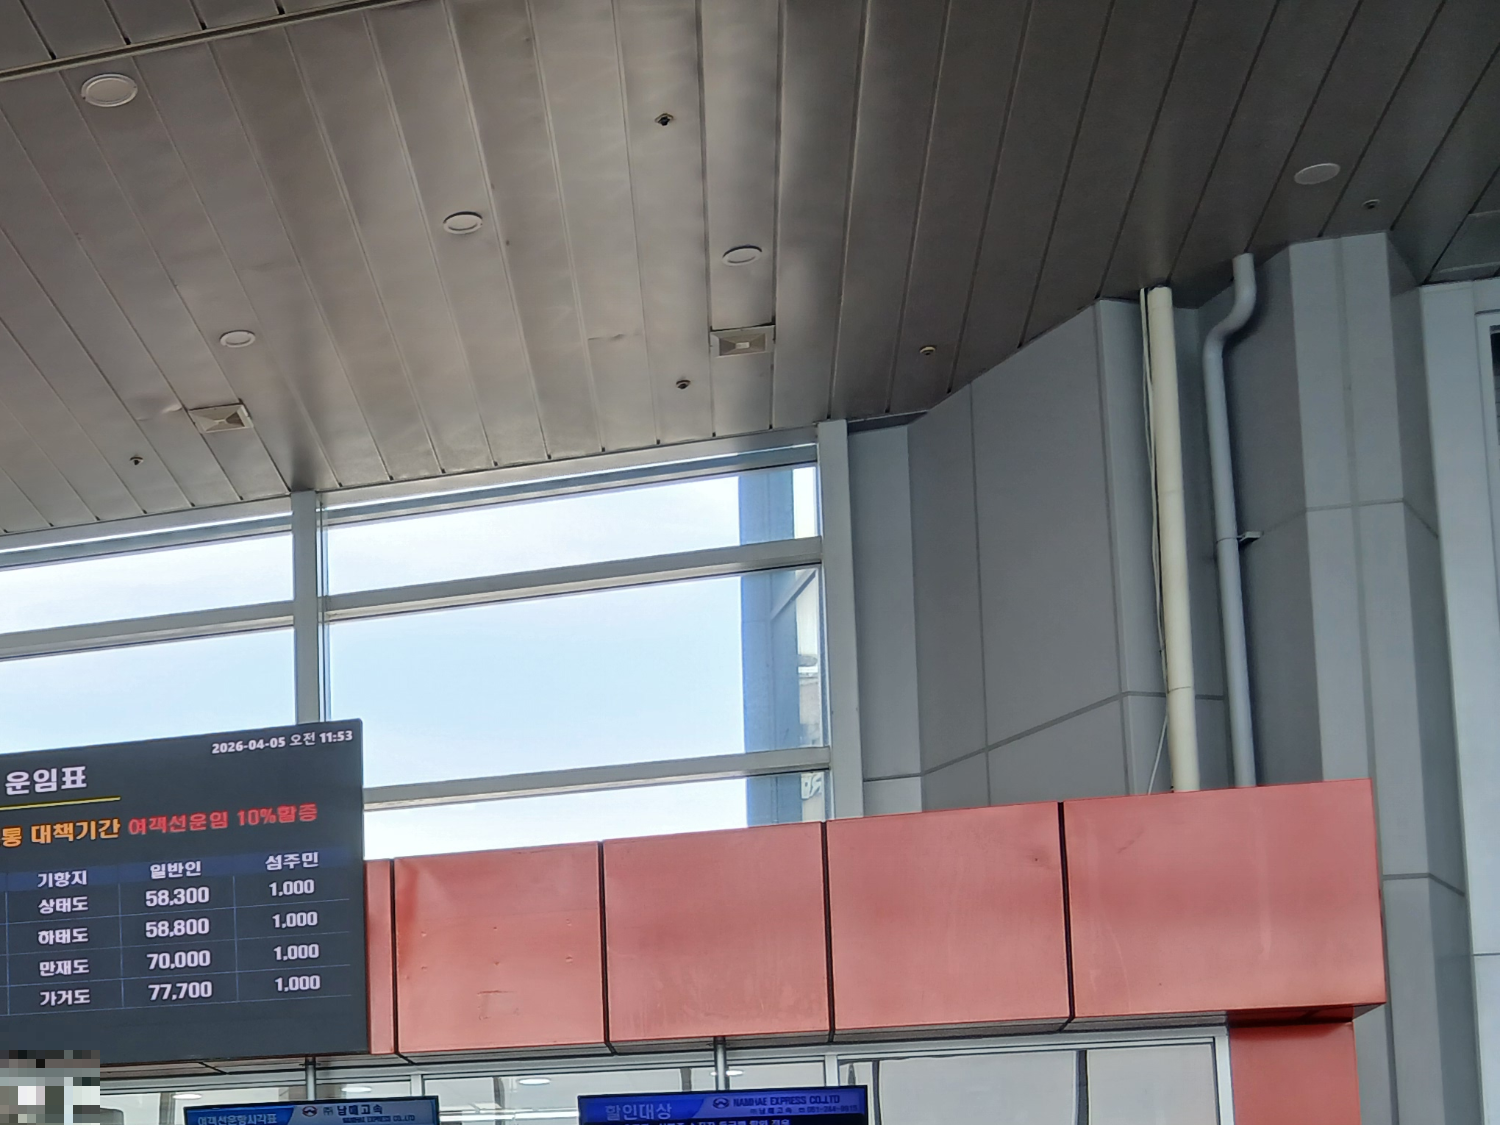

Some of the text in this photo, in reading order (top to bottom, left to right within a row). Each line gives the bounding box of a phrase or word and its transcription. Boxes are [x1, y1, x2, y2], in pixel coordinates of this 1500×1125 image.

[211, 730, 352, 755] 2026-04-05 오전 11:53
[5, 766, 87, 796] 운임표
[30, 817, 120, 845] 대책기간
[127, 808, 228, 837] 여객선운임
[237, 802, 318, 828] 10%할증
[36, 869, 88, 888] 기항지
[149, 860, 202, 878] 일반인
[264, 850, 319, 871] 섬주민
[38, 895, 89, 915] 상태도
[145, 886, 210, 908] 58,300
[268, 878, 315, 898] 1,000
[38, 926, 88, 946] 하태도
[145, 917, 209, 937] 58,800
[272, 911, 318, 929] 1,000
[39, 957, 89, 977] 만재도
[147, 949, 211, 970] 70,000
[273, 943, 319, 962] 1,000
[39, 988, 90, 1006] 가거도
[148, 980, 212, 1001] 77,700
[274, 974, 320, 993] 1,000
[605, 1104, 671, 1121] 할인대상
